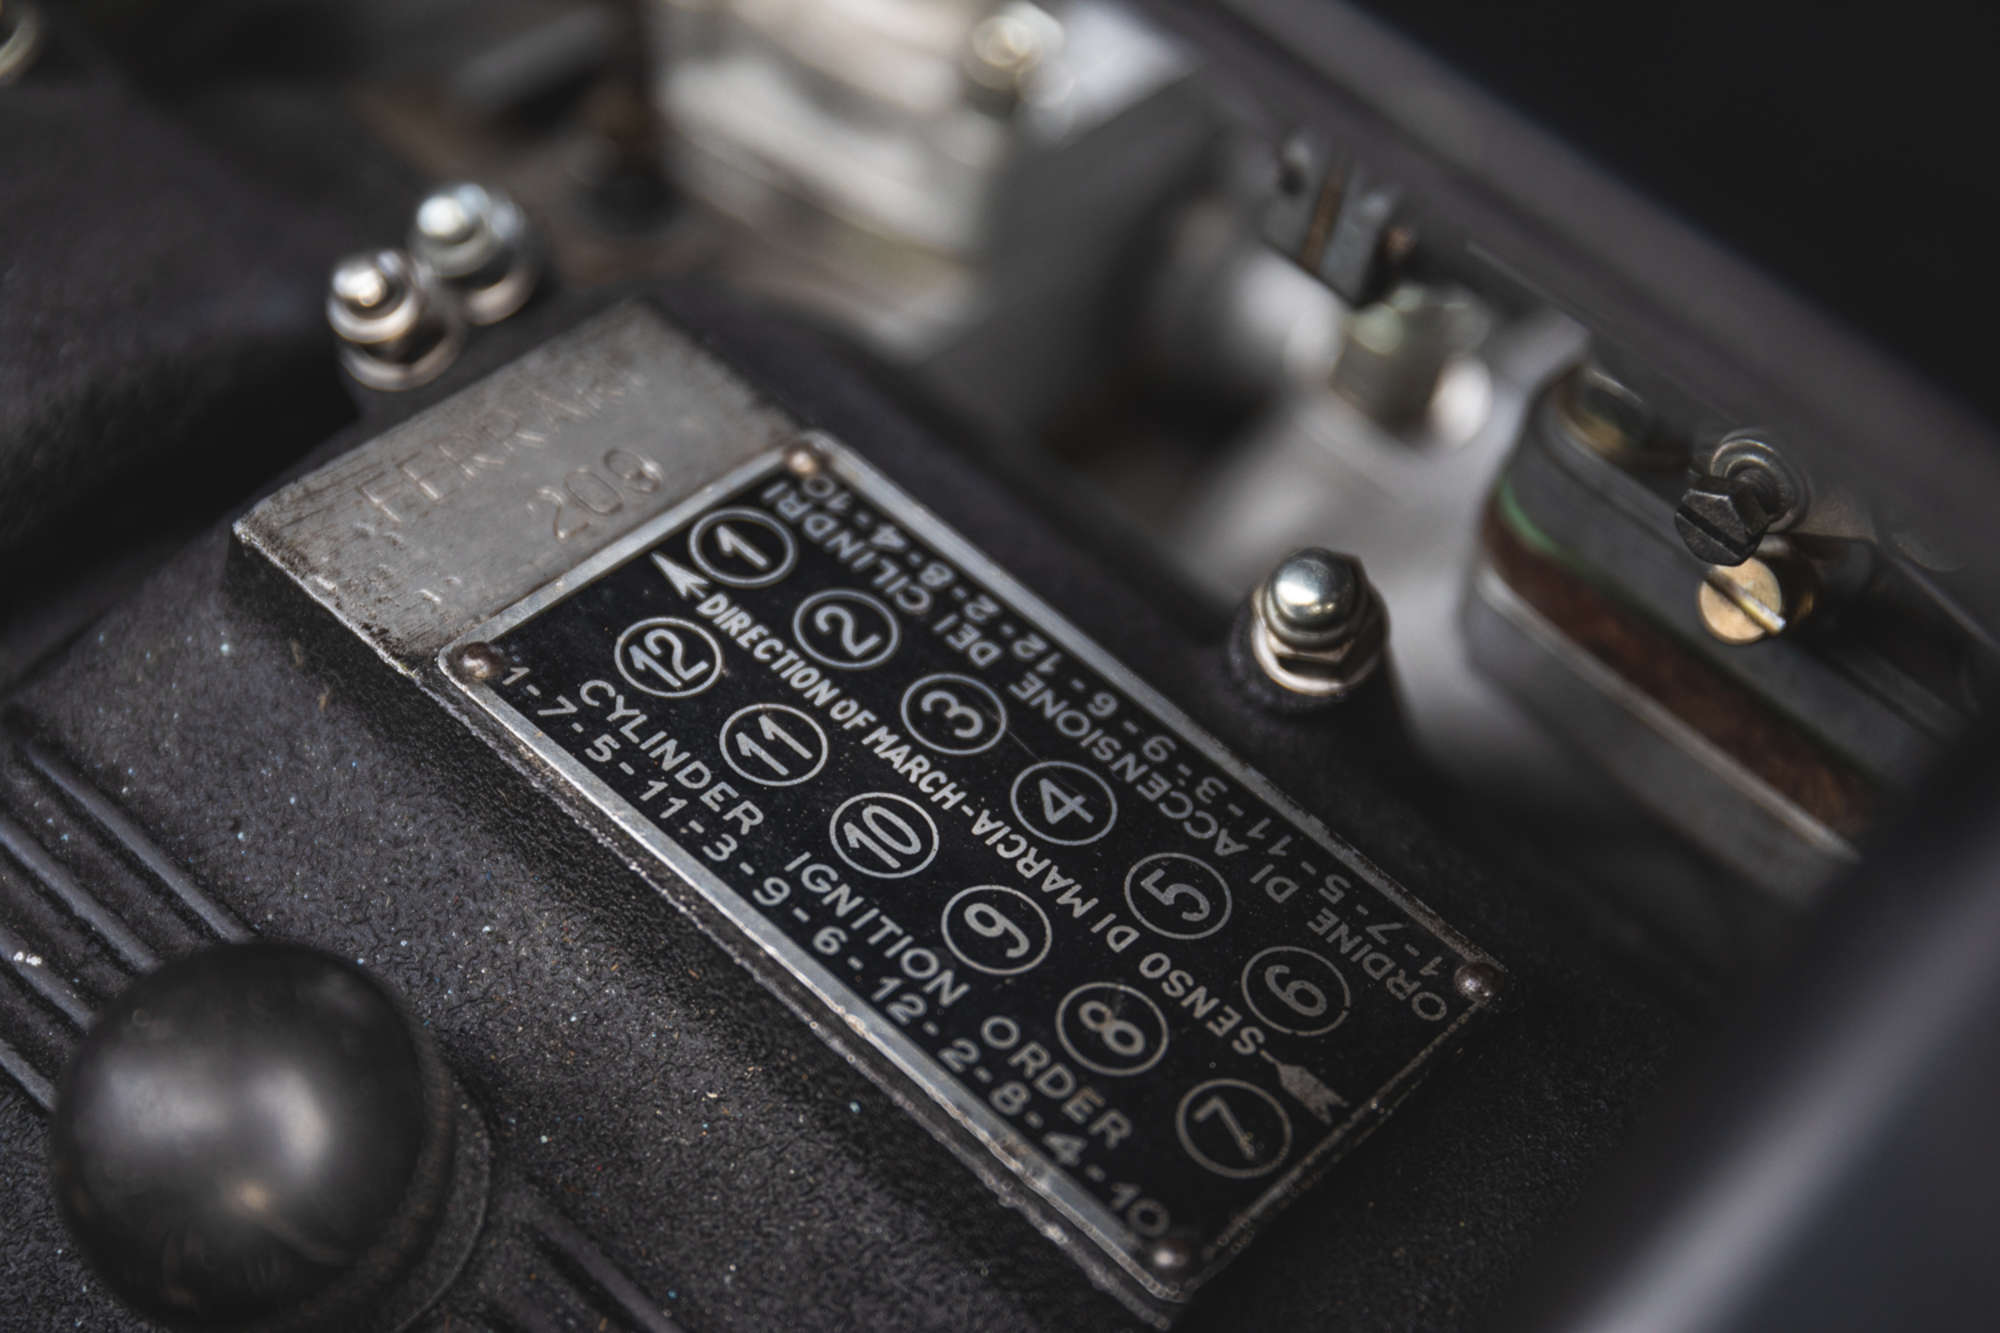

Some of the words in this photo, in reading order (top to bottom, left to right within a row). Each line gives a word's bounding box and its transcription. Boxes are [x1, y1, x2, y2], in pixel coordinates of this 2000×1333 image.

[716, 523, 768, 570] 1
[762, 482, 931, 613] CILINDRI
[628, 627, 709, 689] 12
[813, 604, 882, 657] 2
[932, 613, 1001, 667] DEI
[695, 592, 840, 707] DIRECTION
[829, 698, 877, 731] OF
[920, 689, 984, 739] 3
[735, 713, 813, 776] 11
[1008, 671, 1249, 857] ACCENSIONE
[1038, 777, 1095, 826] 4
[844, 804, 921, 870] 10
[1140, 867, 1211, 923] 5
[1250, 864, 1300, 903] DI
[578, 679, 764, 835] CYLINDER
[784, 851, 971, 1007] IGNITION
[980, 1016, 1133, 1149] ORDER
[964, 902, 1031, 959] 9
[1090, 912, 1141, 953] DI
[1264, 964, 1328, 1017] 6
[1307, 907, 1447, 1021] ORDINE
[1079, 999, 1145, 1057] 8
[1138, 951, 1266, 1056] SENSO
[1195, 1095, 1257, 1160] 7
